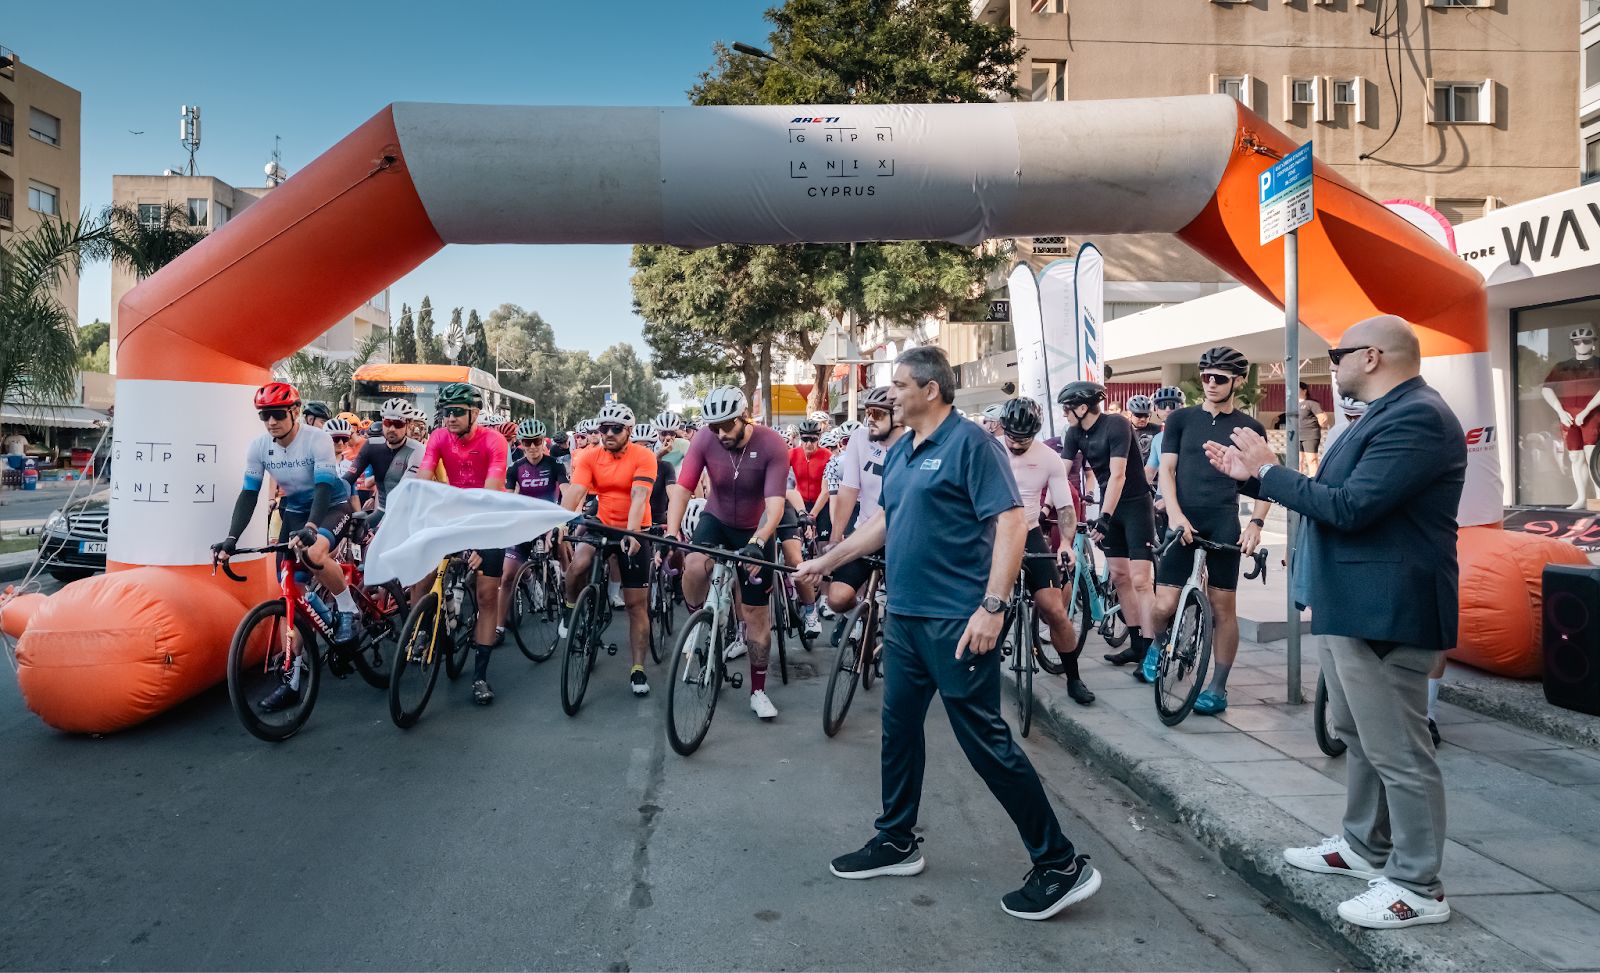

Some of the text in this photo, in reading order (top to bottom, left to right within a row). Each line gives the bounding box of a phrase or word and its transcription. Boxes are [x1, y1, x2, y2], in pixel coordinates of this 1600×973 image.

[807, 186, 875, 197] CYPRUS
[1261, 171, 1271, 202] P
[1458, 246, 1496, 261] TORE
[262, 458, 315, 471] RoboMarkets
[88, 543, 107, 552] KTU
